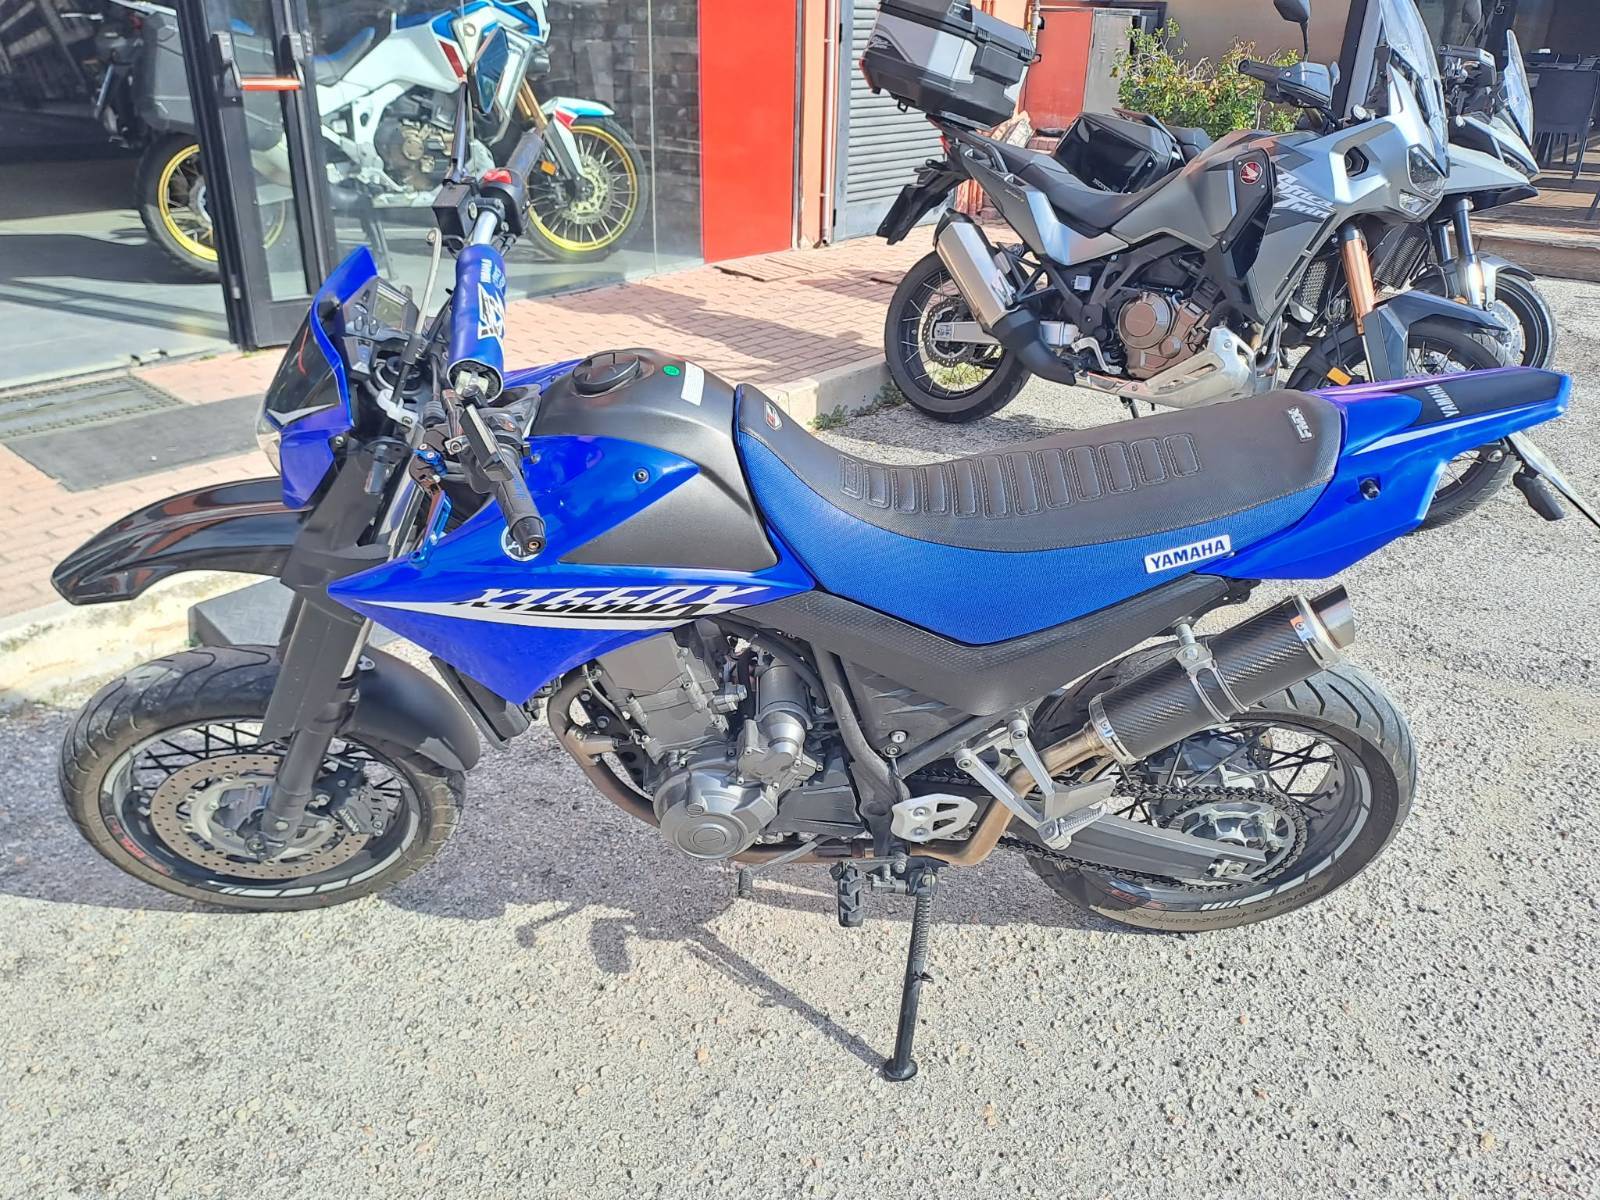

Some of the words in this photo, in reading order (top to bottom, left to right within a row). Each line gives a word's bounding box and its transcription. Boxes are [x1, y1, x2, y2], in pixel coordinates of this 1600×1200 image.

[1424, 384, 1460, 418] YAMAHA
[1150, 540, 1226, 569] YAMAHA
[462, 586, 770, 617] XT660X
